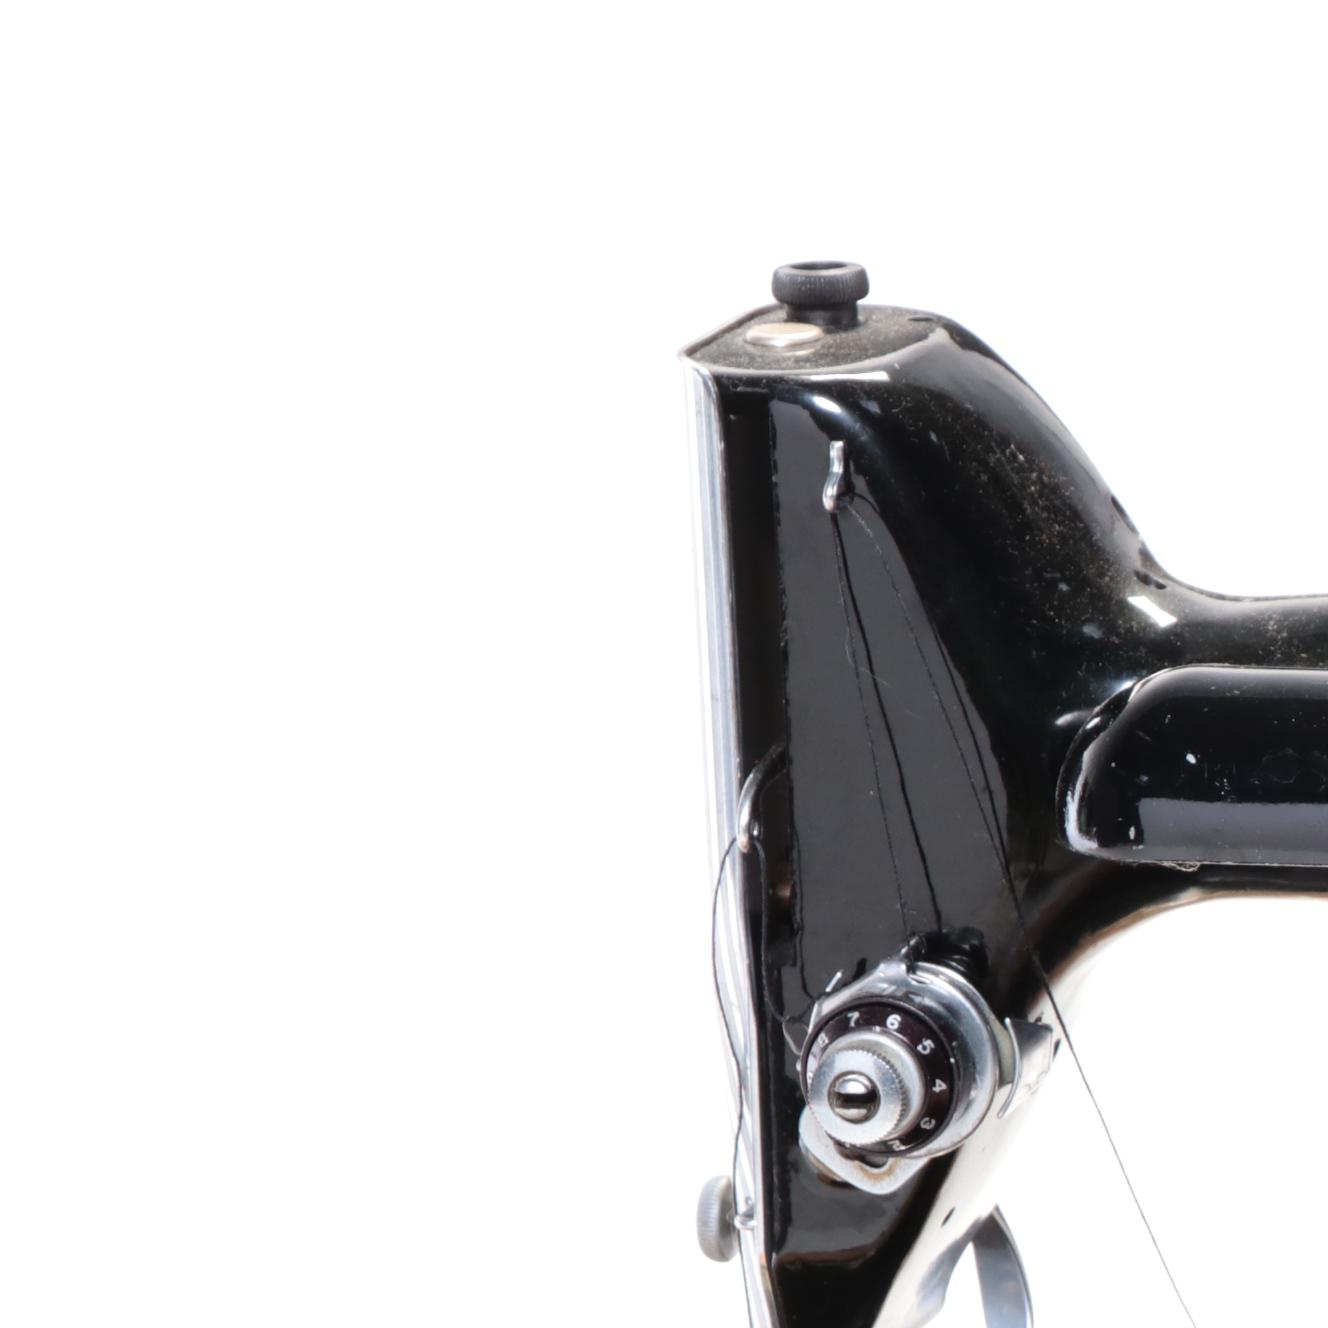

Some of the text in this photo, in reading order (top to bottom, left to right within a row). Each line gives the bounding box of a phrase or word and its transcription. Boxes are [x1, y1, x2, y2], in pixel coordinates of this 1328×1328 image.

[847, 1011, 860, 1027] 7
[886, 1014, 901, 1029] 6
[917, 1038, 935, 1055] 5
[932, 1079, 947, 1093] 4
[920, 1117, 936, 1130] 3
